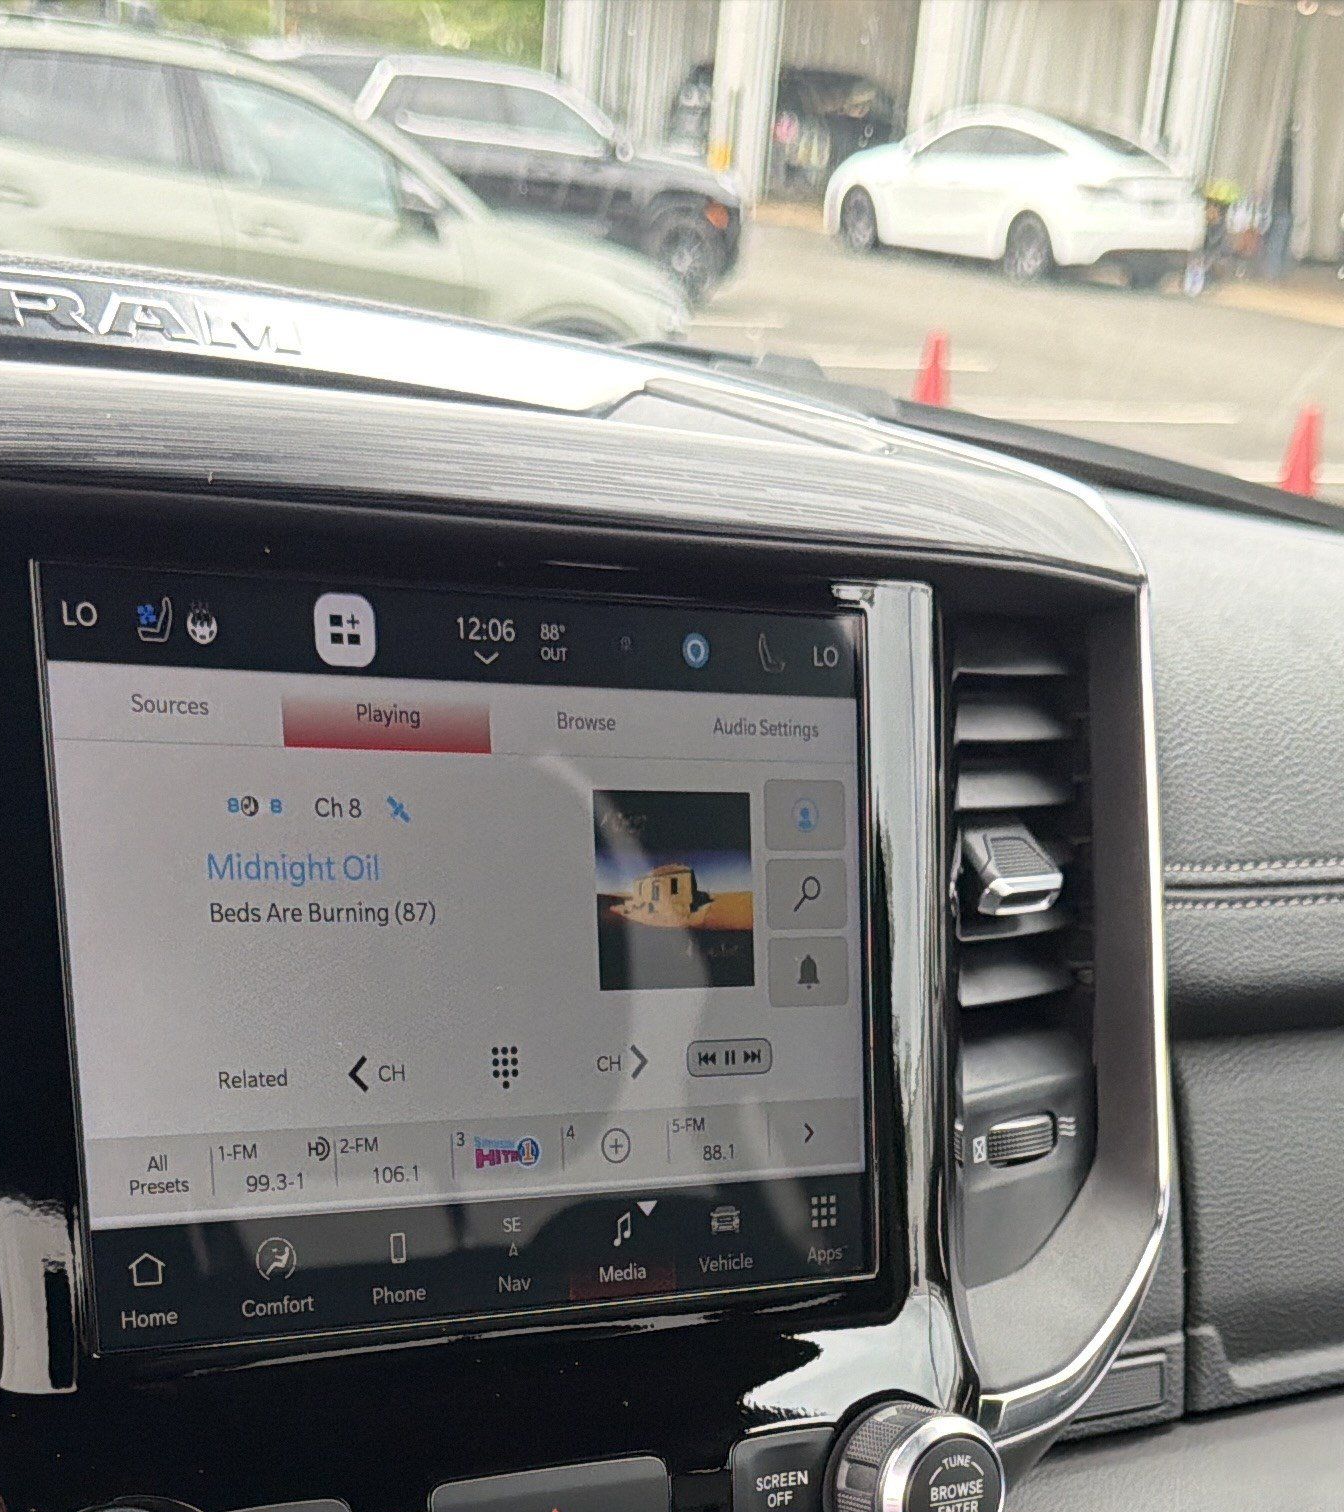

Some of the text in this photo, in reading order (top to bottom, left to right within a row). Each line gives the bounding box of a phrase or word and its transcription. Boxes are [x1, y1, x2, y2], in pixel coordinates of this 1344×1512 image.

[62, 600, 98, 627] LO
[456, 616, 516, 643] 12:06
[541, 646, 568, 662] OUT
[812, 645, 839, 668] LO
[131, 693, 210, 716] Sources
[356, 704, 421, 729] Playing
[557, 711, 616, 732] Browse
[713, 717, 820, 742] Audio Settings
[314, 797, 362, 818] Ch 8
[206, 853, 380, 887] Midnight Oil
[209, 901, 436, 927] Beds Are Burning (87)
[597, 1055, 622, 1073] CH
[218, 1069, 288, 1090] Related
[378, 1065, 406, 1083] CH
[566, 1125, 575, 1140] 4
[672, 1117, 706, 1134] 5-FM
[339, 1136, 379, 1155] 2-FM
[456, 1131, 465, 1147] 3
[218, 1144, 258, 1162] 1-FM
[702, 1144, 735, 1161] 88.1
[146, 1155, 167, 1172] All
[245, 1173, 305, 1193] 99.3-1
[372, 1166, 420, 1185] 106.1
[129, 1178, 190, 1196] Presets
[502, 1217, 522, 1233] SE
[699, 1253, 754, 1273] Vehicle
[807, 1246, 842, 1267] Apps
[598, 1264, 648, 1283] Media
[498, 1275, 532, 1293] Nav
[372, 1286, 427, 1305] Phone
[241, 1295, 315, 1318] Comfort
[121, 1309, 178, 1329] Home
[942, 1454, 972, 1470] TUNE
[756, 1469, 809, 1493] SCREEN
[929, 1478, 984, 1502] BROWSE
[766, 1490, 793, 1508] OFF
